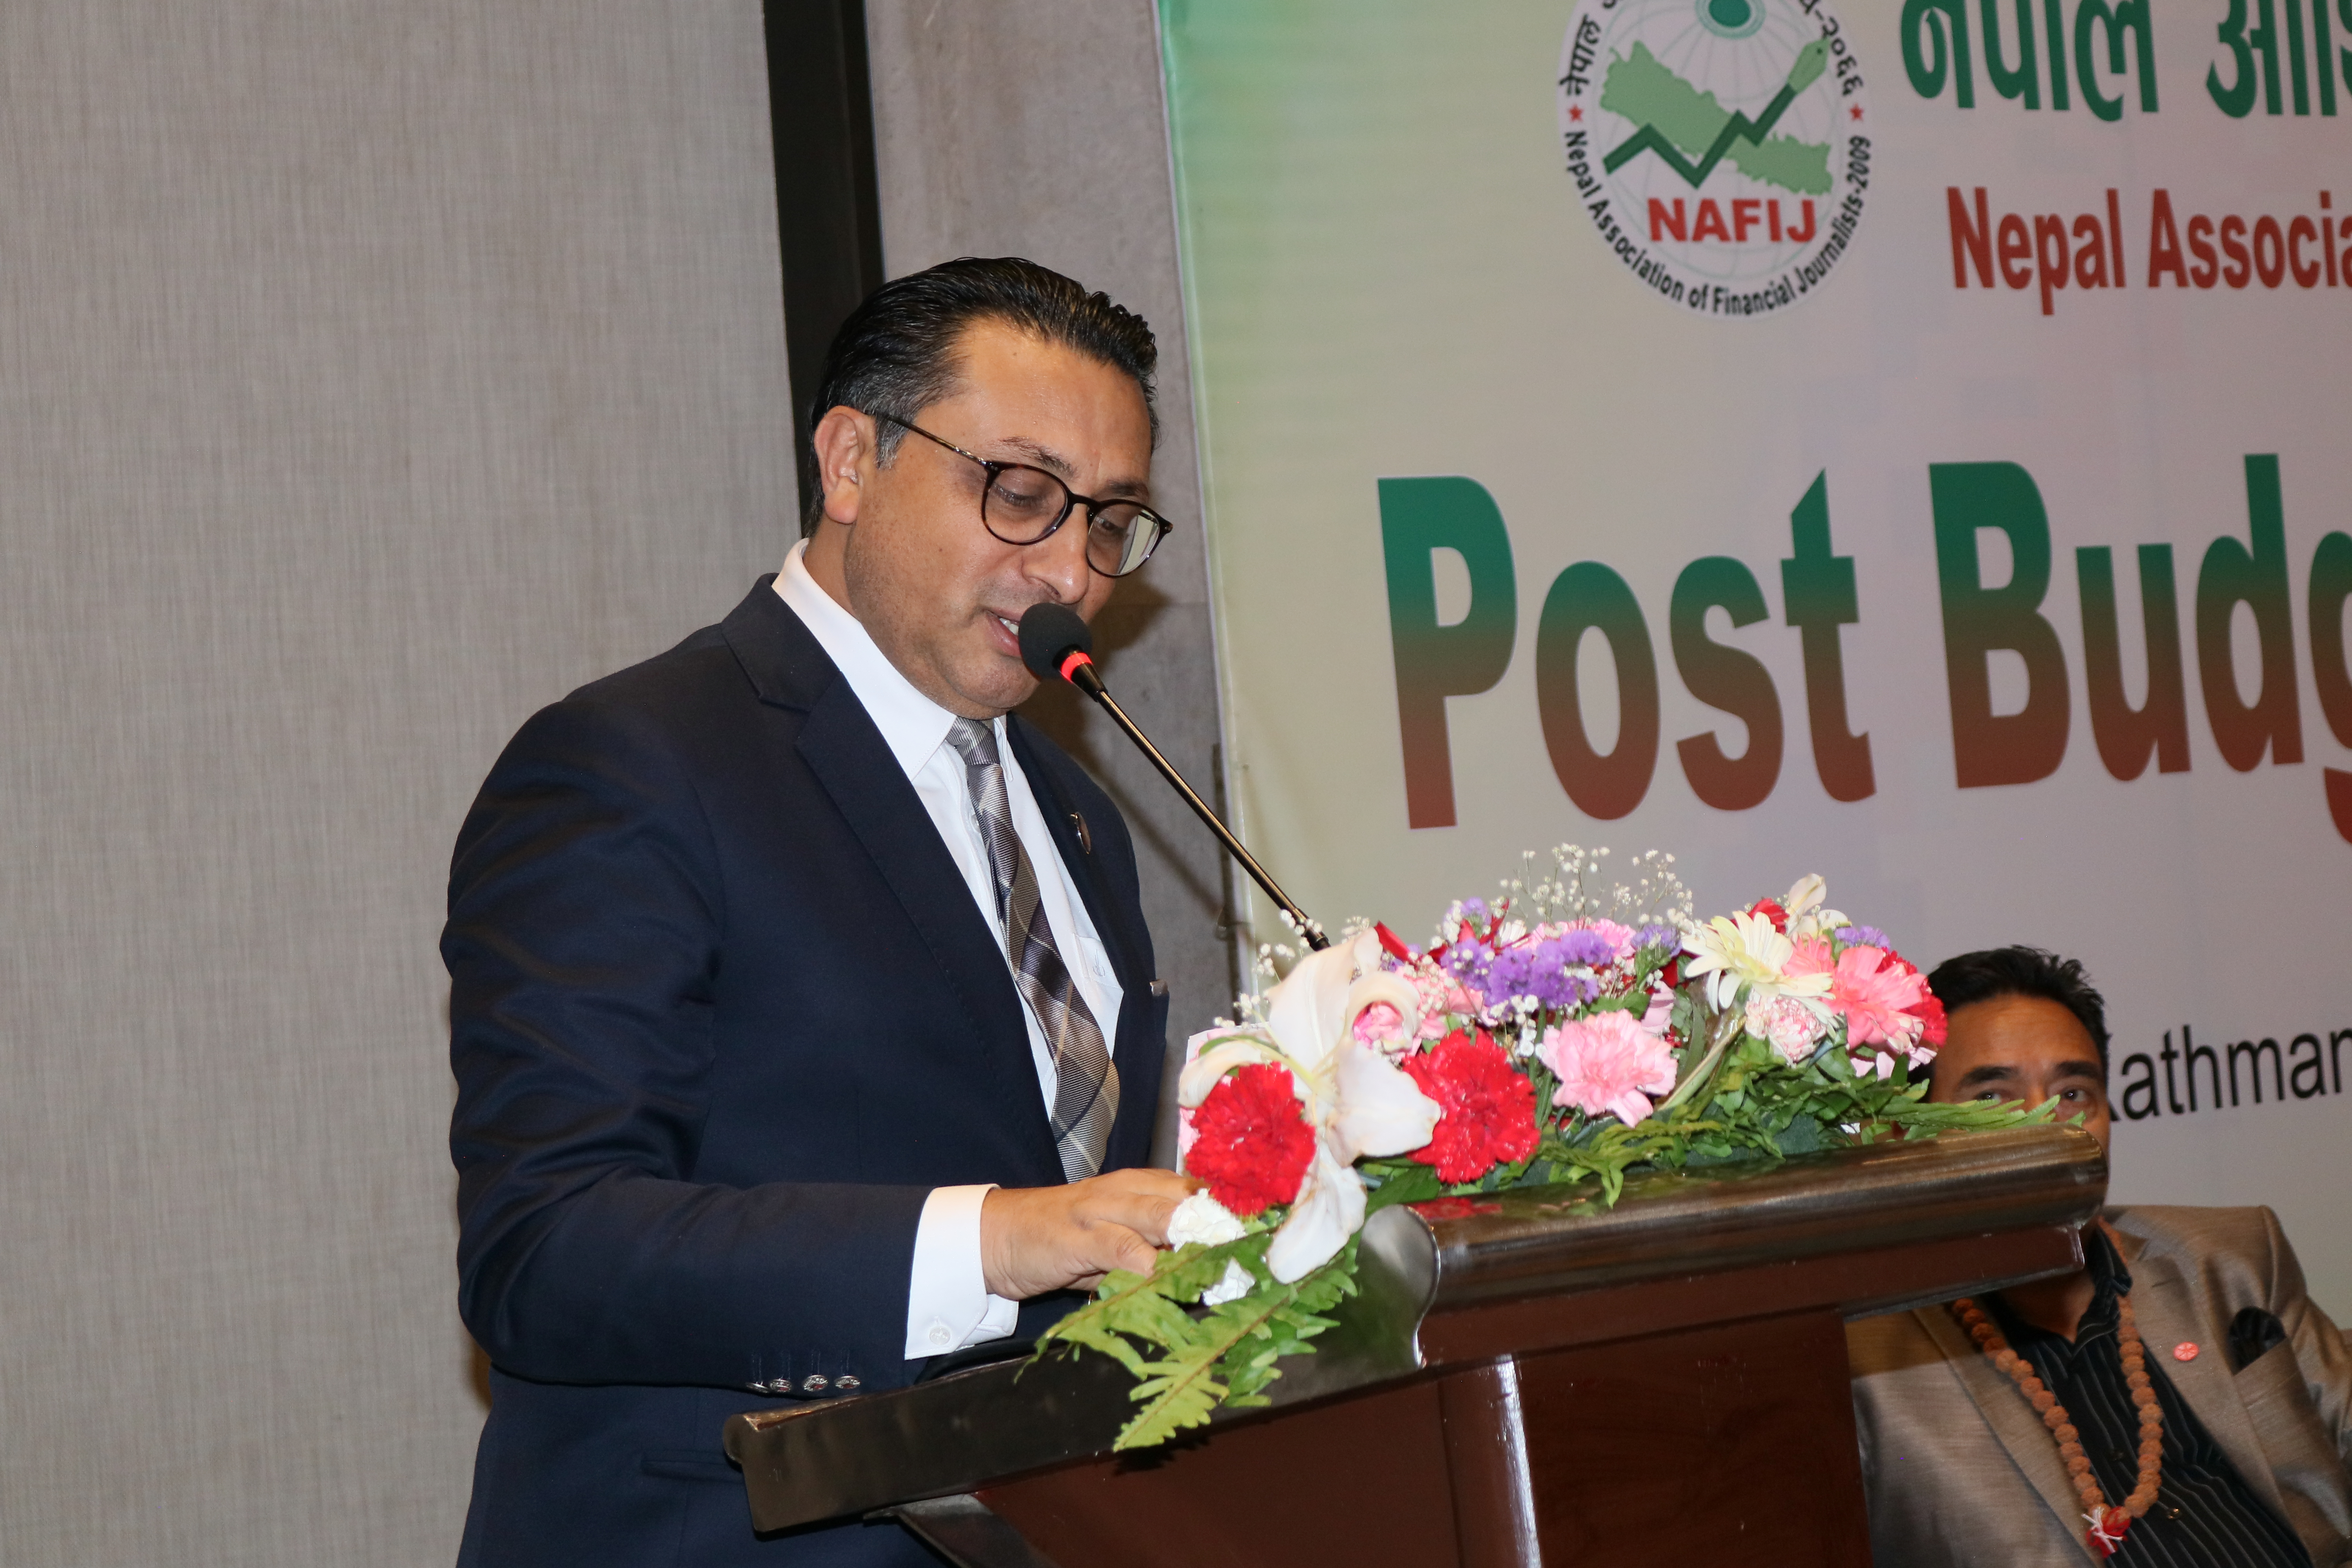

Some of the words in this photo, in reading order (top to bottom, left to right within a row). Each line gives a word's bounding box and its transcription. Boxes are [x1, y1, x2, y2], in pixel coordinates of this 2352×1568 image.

[1559, 14, 1601, 95] नेपाल
[1564, 131, 1602, 198] Nepal
[1588, 199, 1684, 302] Association
[1688, 284, 1709, 310] of
[1713, 275, 1796, 316] Financial
[1795, 135, 1871, 294] Journalists-2009
[1648, 198, 1817, 243] NAFIJ
[1947, 187, 2126, 316] Nepal
[1377, 468, 1877, 829] Post
